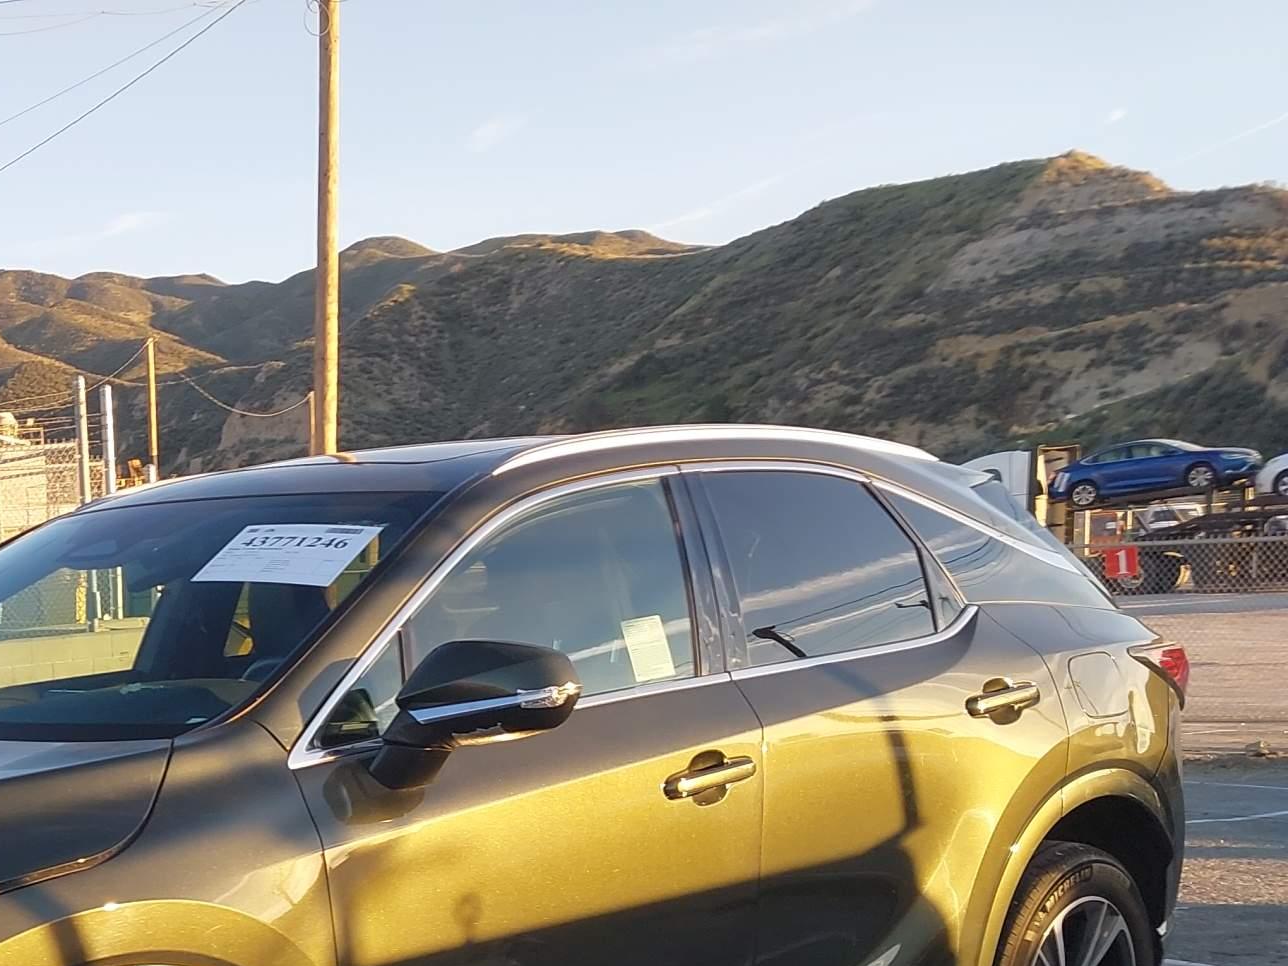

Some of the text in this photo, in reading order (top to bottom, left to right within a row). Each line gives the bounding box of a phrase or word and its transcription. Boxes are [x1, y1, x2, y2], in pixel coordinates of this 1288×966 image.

[241, 535, 350, 550] 43771246
[1115, 549, 1131, 575] 1
[1045, 866, 1092, 912] MICHELIN
